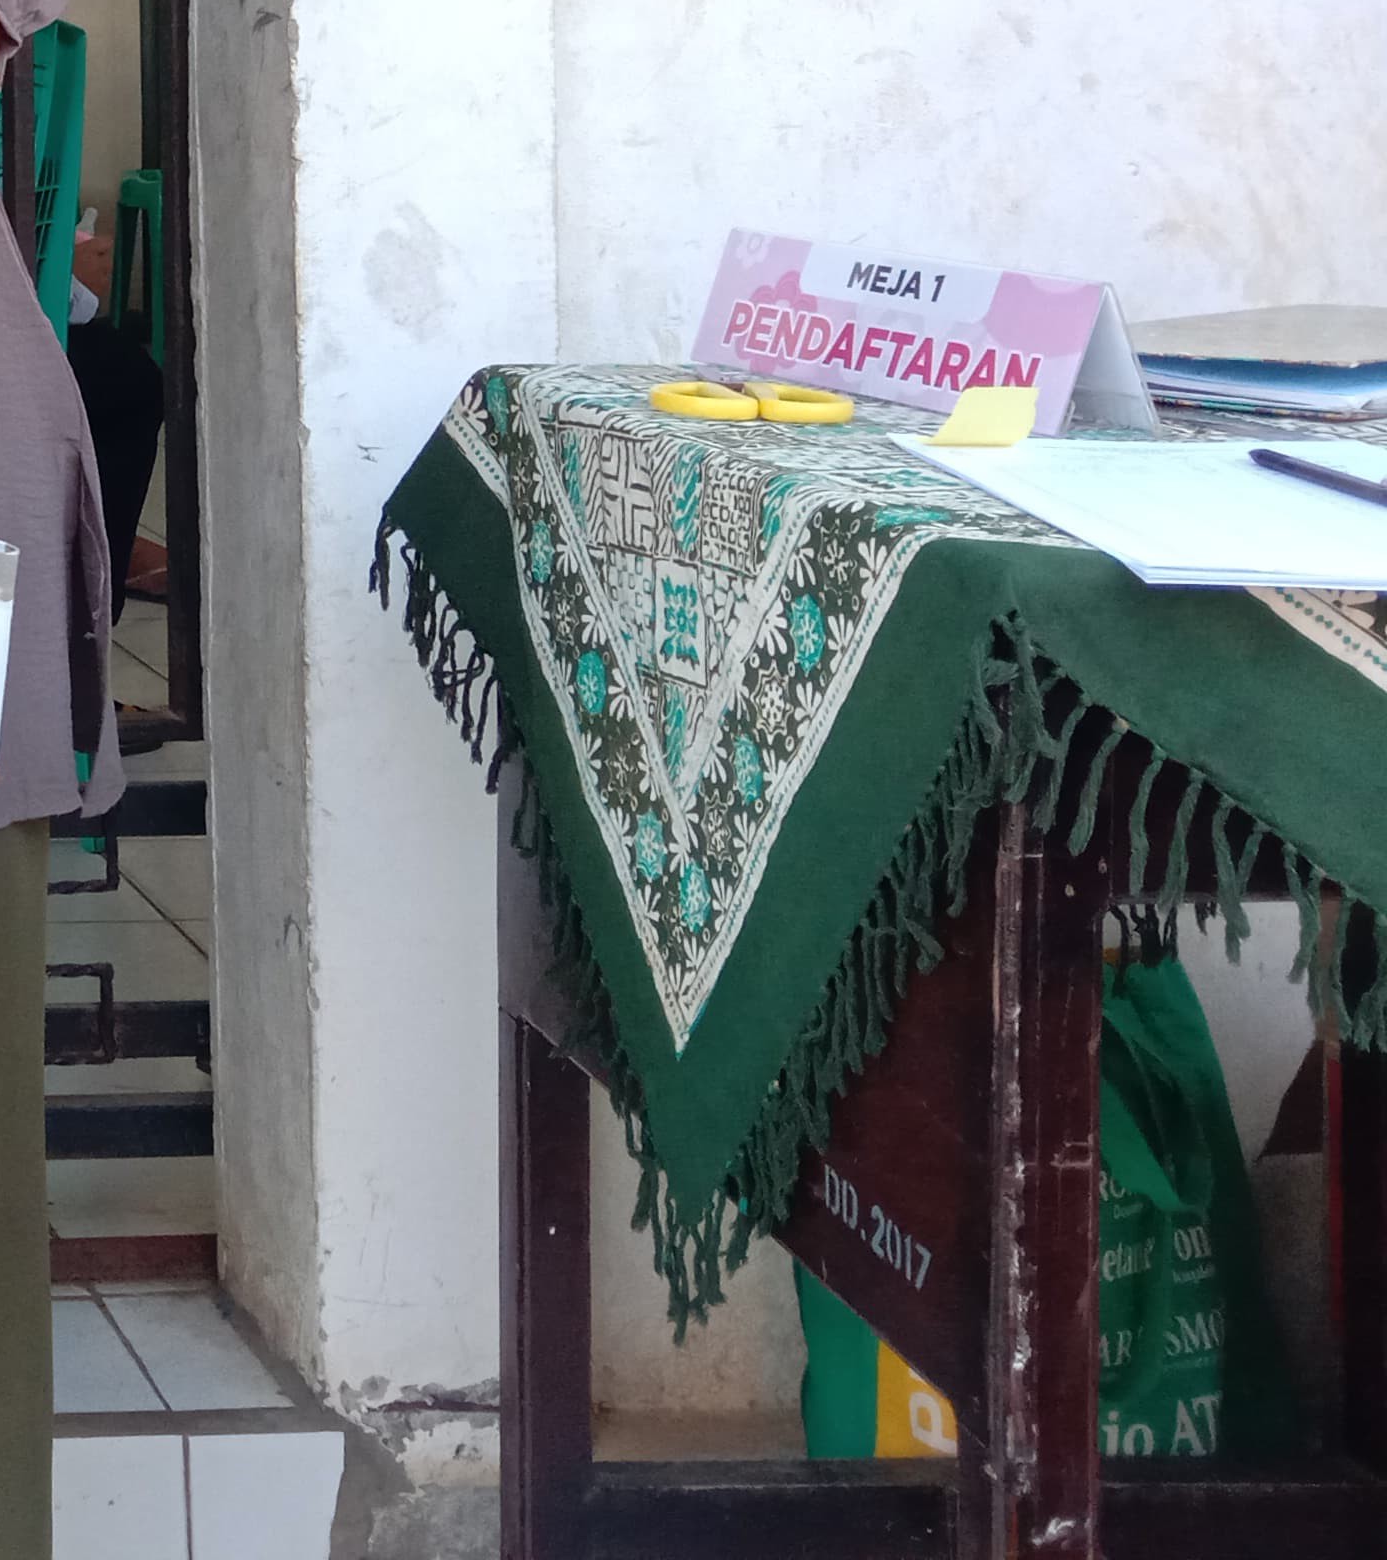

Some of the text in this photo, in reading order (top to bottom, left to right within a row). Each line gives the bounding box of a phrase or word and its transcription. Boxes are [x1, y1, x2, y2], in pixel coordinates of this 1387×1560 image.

[846, 261, 946, 303] MEJA 1
[722, 301, 1042, 393] PENDAFTARAN
